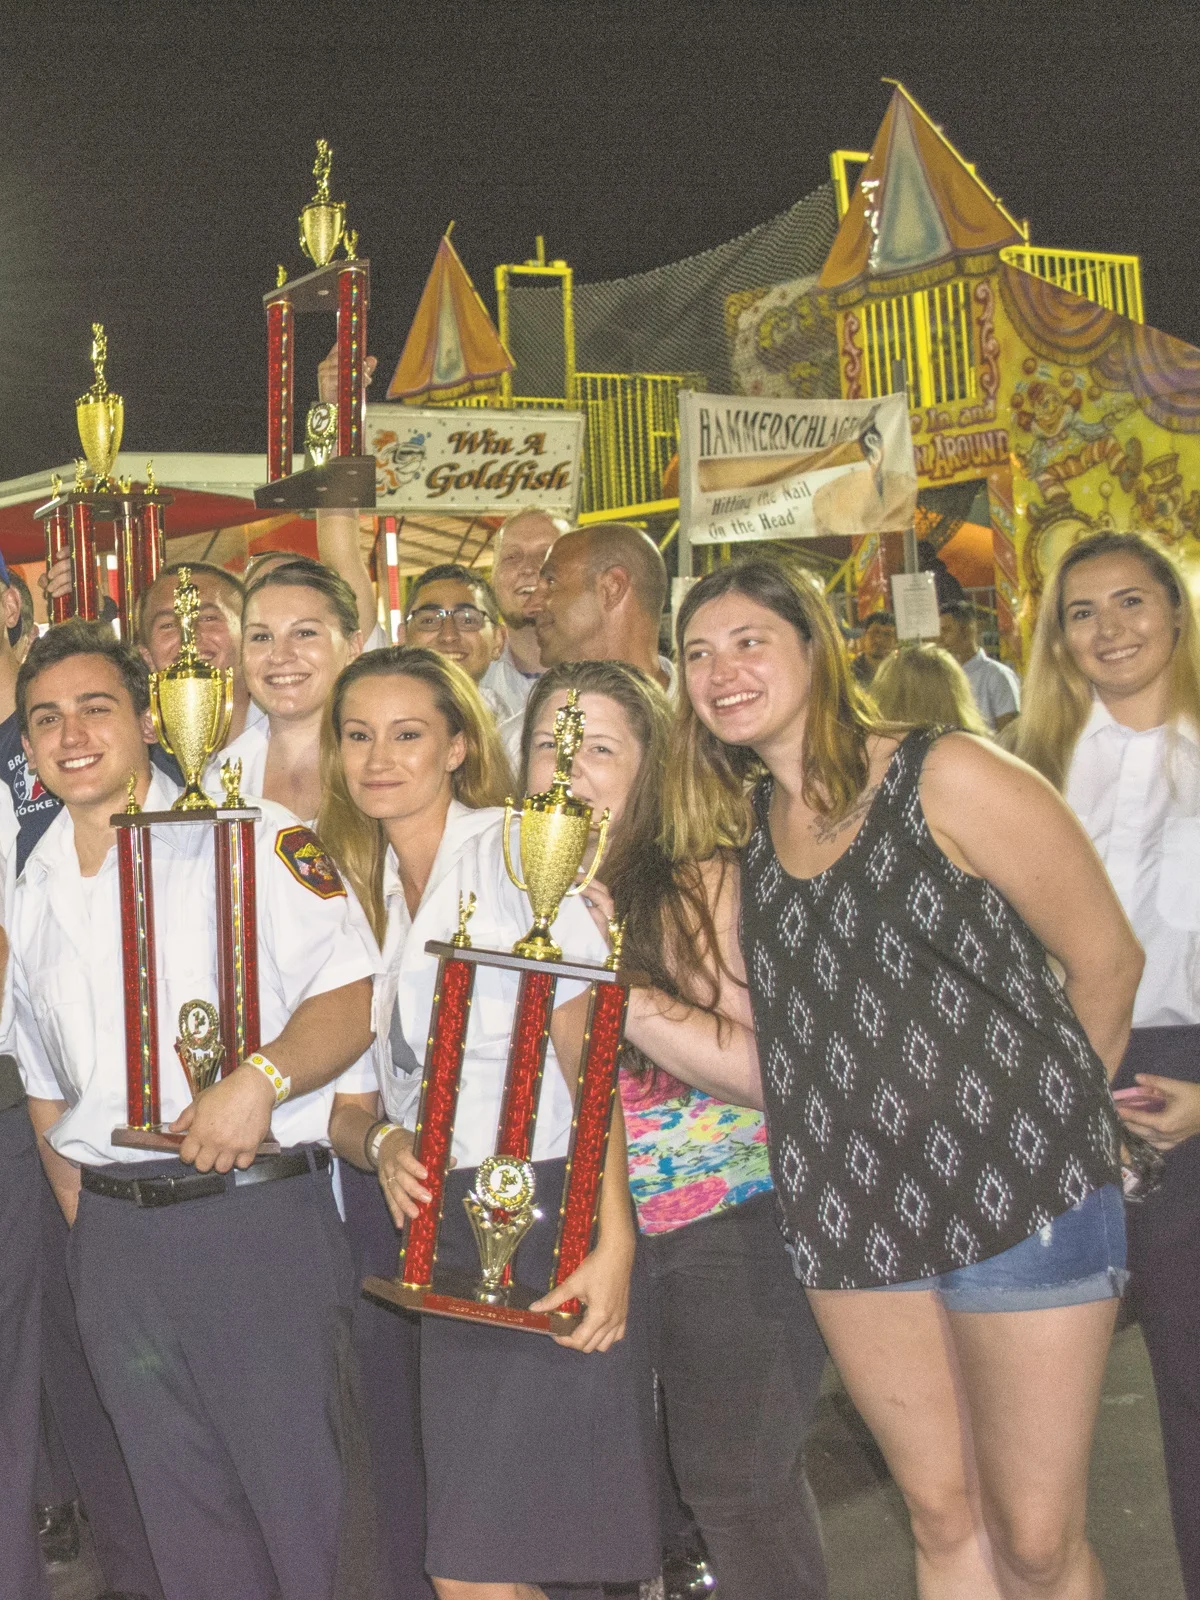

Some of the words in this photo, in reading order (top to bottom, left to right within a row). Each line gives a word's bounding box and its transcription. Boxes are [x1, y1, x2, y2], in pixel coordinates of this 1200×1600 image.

[448, 427, 515, 455] Win
[515, 432, 548, 456] A
[699, 407, 862, 456] HAMMERSCHLAGE
[928, 429, 1009, 480] AROUND
[425, 459, 573, 499] Goldfish
[782, 481, 812, 501] Nail
[708, 521, 726, 540] On
[731, 518, 756, 535] the
[7, 752, 28, 771] BRA
